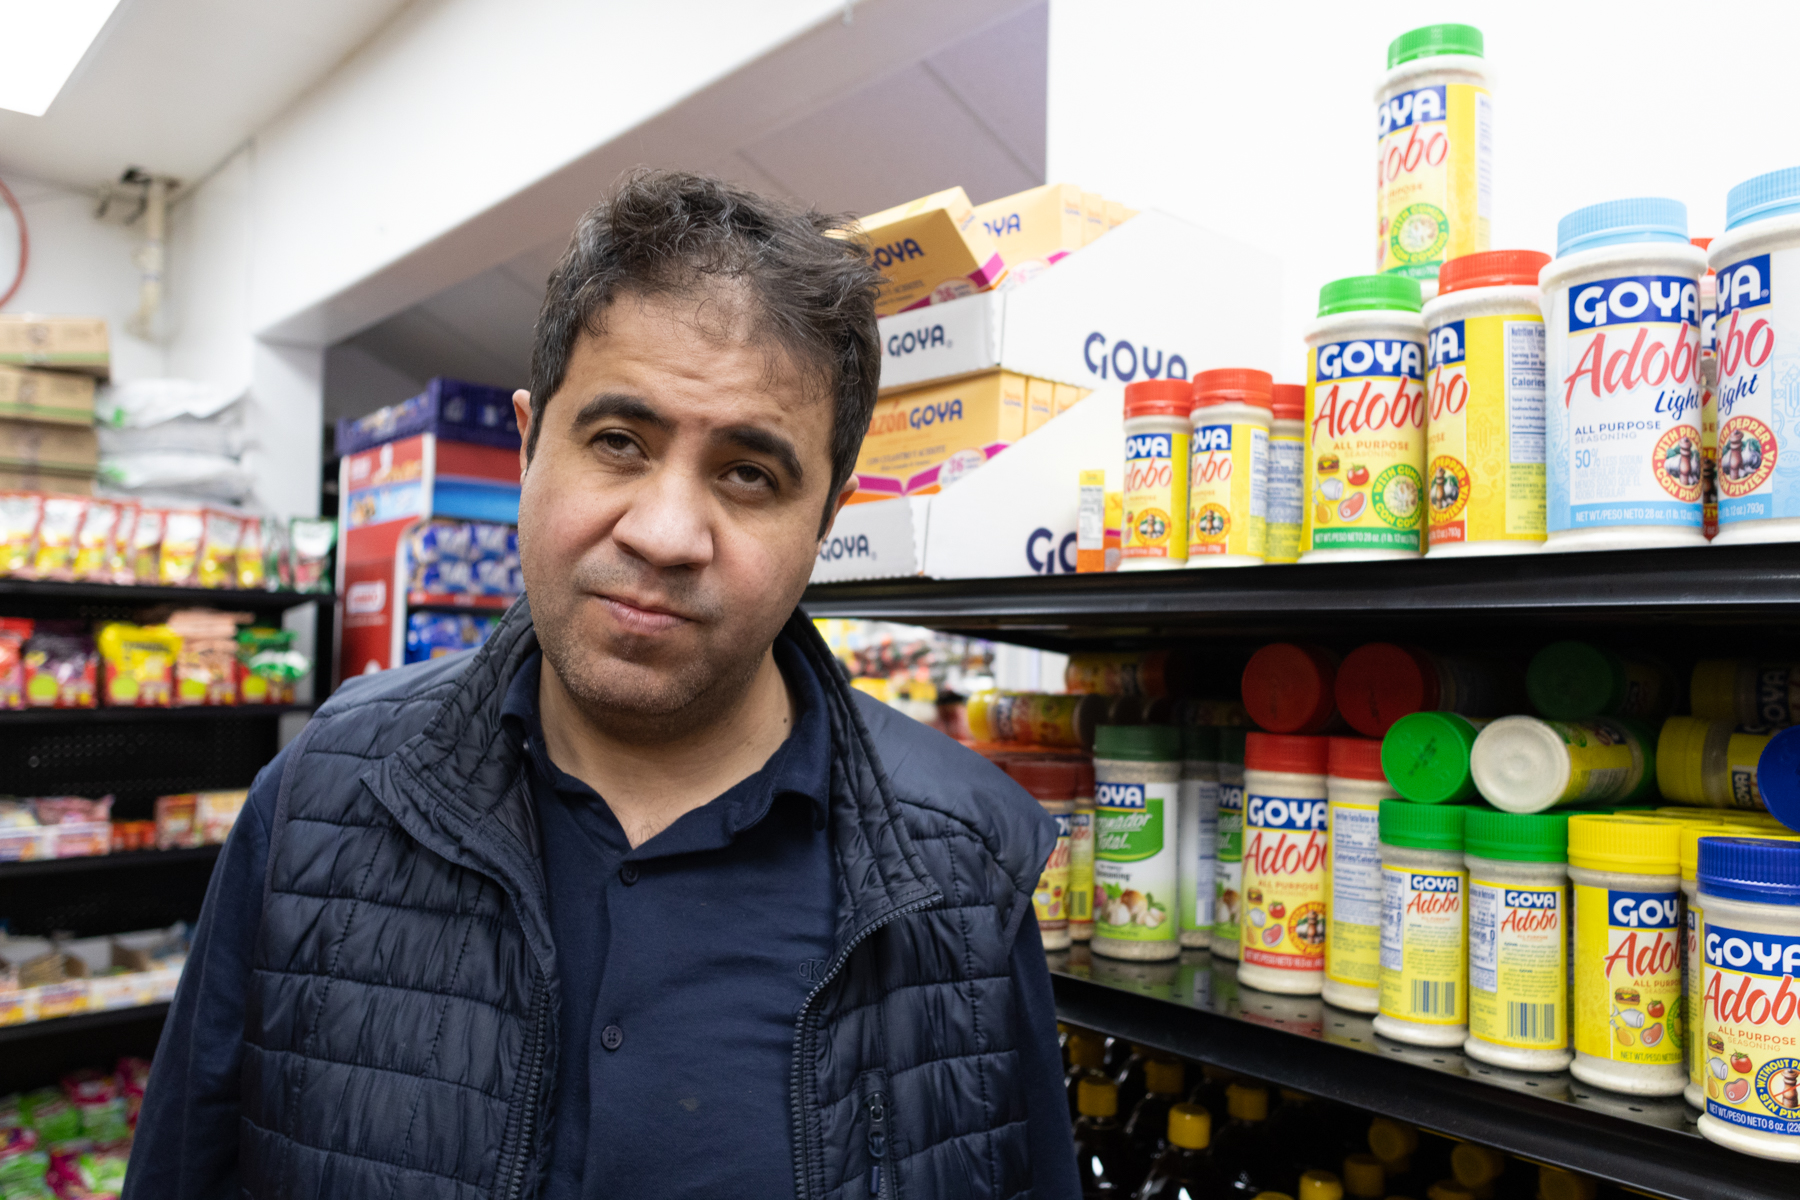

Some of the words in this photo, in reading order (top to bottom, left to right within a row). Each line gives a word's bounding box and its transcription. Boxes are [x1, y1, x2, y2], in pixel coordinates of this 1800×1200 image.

[1378, 89, 1441, 132] OYA
[872, 238, 926, 271] OYA
[1717, 265, 1760, 313] YA
[1574, 281, 1699, 327] GOYA
[887, 325, 944, 357] GOYA
[1428, 327, 1458, 367] YA
[1084, 332, 1188, 382] GOYA
[1320, 341, 1422, 378] GOYA
[867, 401, 908, 437] azón
[909, 398, 963, 430] GOYA
[1312, 377, 1424, 447] Adobo
[1654, 387, 1700, 421] Light
[1192, 428, 1229, 453] OYA
[1575, 425, 1595, 436] ALL
[1599, 420, 1661, 432] PURPOSE
[1575, 431, 1637, 444] SEASONING
[1730, 418, 1771, 443] PEPPER
[1126, 436, 1169, 459] OYA
[1356, 440, 1409, 451] PURPOSE
[1654, 430, 1679, 459] WITH
[1656, 468, 1679, 495] CON
[1729, 450, 1775, 496] PIMIENTA
[1624, 508, 1644, 520] NETO
[1645, 508, 1655, 519] 28
[1026, 527, 1078, 574] GO
[1762, 670, 1788, 729] OYA
[1096, 784, 1143, 806] OYA
[1219, 787, 1242, 807] YA
[1733, 772, 1752, 806] OYA
[1250, 797, 1327, 828] GOYA
[1243, 829, 1327, 877] Adob
[1275, 880, 1319, 891] PURPOSE
[1412, 876, 1458, 891] GOYA
[1406, 890, 1459, 915] Adobo
[1506, 891, 1555, 908] GOYA
[1613, 898, 1678, 927] GOY
[1500, 907, 1557, 933] Adobo
[1604, 931, 1681, 979] Adob
[1633, 980, 1651, 988] ALL
[1703, 970, 1800, 1026] Adob
[1718, 1025, 1735, 1037] ALL
[1738, 1030, 1797, 1046] PURPOSE
[1727, 1036, 1781, 1052] SEASONING
[1757, 1059, 1789, 1088] WITHOUT
[1760, 1093, 1779, 1112] SIN
[1709, 1102, 1719, 1114] NET
[1747, 1115, 1768, 1129] NETO
[1768, 1119, 1774, 1130] 8
[1774, 1122, 1786, 1132] oz.
[1787, 1120, 1800, 1134] (226
